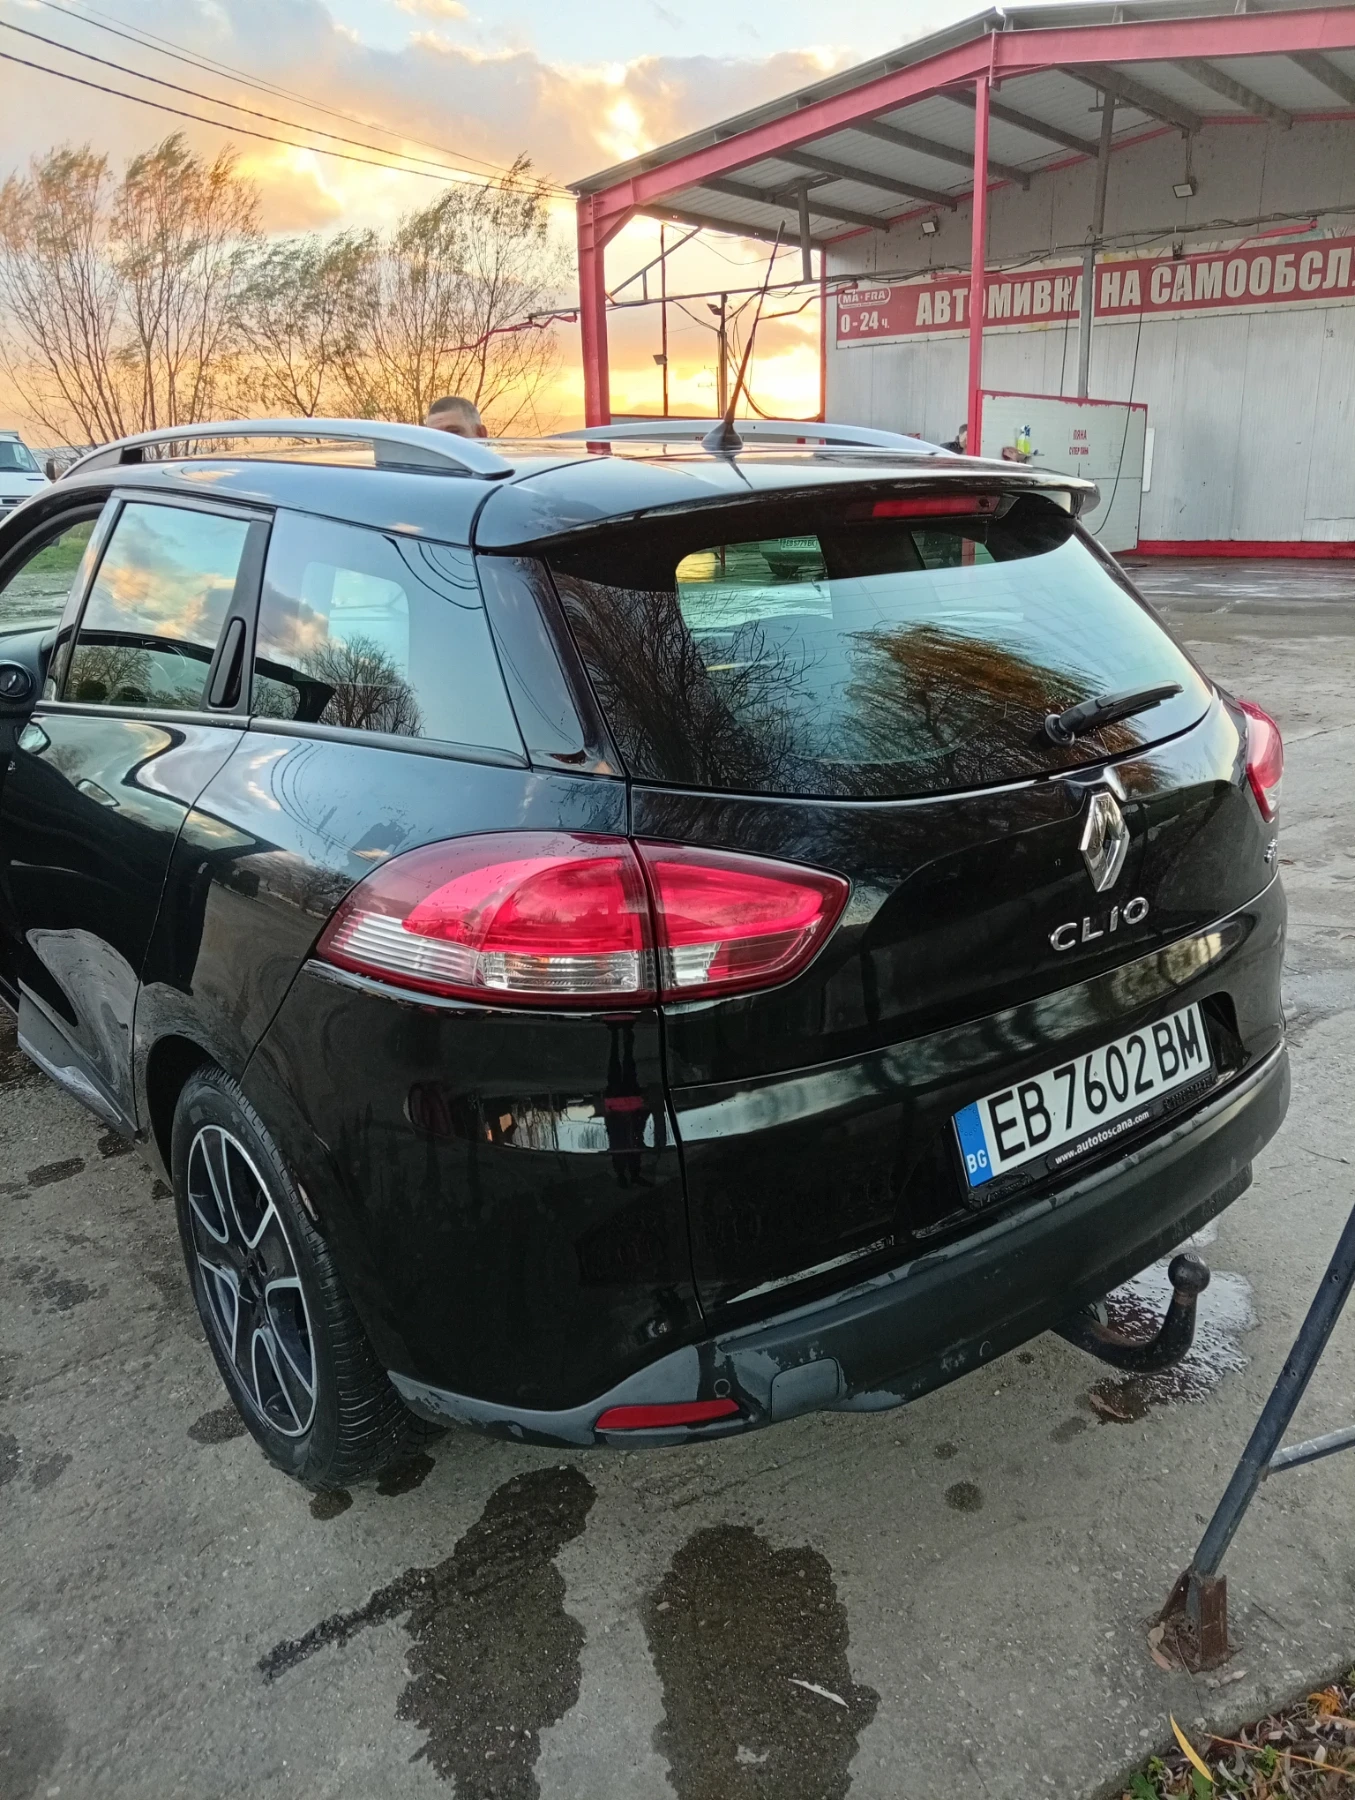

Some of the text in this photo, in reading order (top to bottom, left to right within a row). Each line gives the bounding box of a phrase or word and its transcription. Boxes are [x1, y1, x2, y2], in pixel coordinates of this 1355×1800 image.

[916, 246, 1355, 327] АВТМИВК НА САМООБСЛ
[1050, 896, 1150, 951] CLIO
[966, 1149, 987, 1174] BG
[1054, 1110, 1150, 1165] www.autotoscana.com
